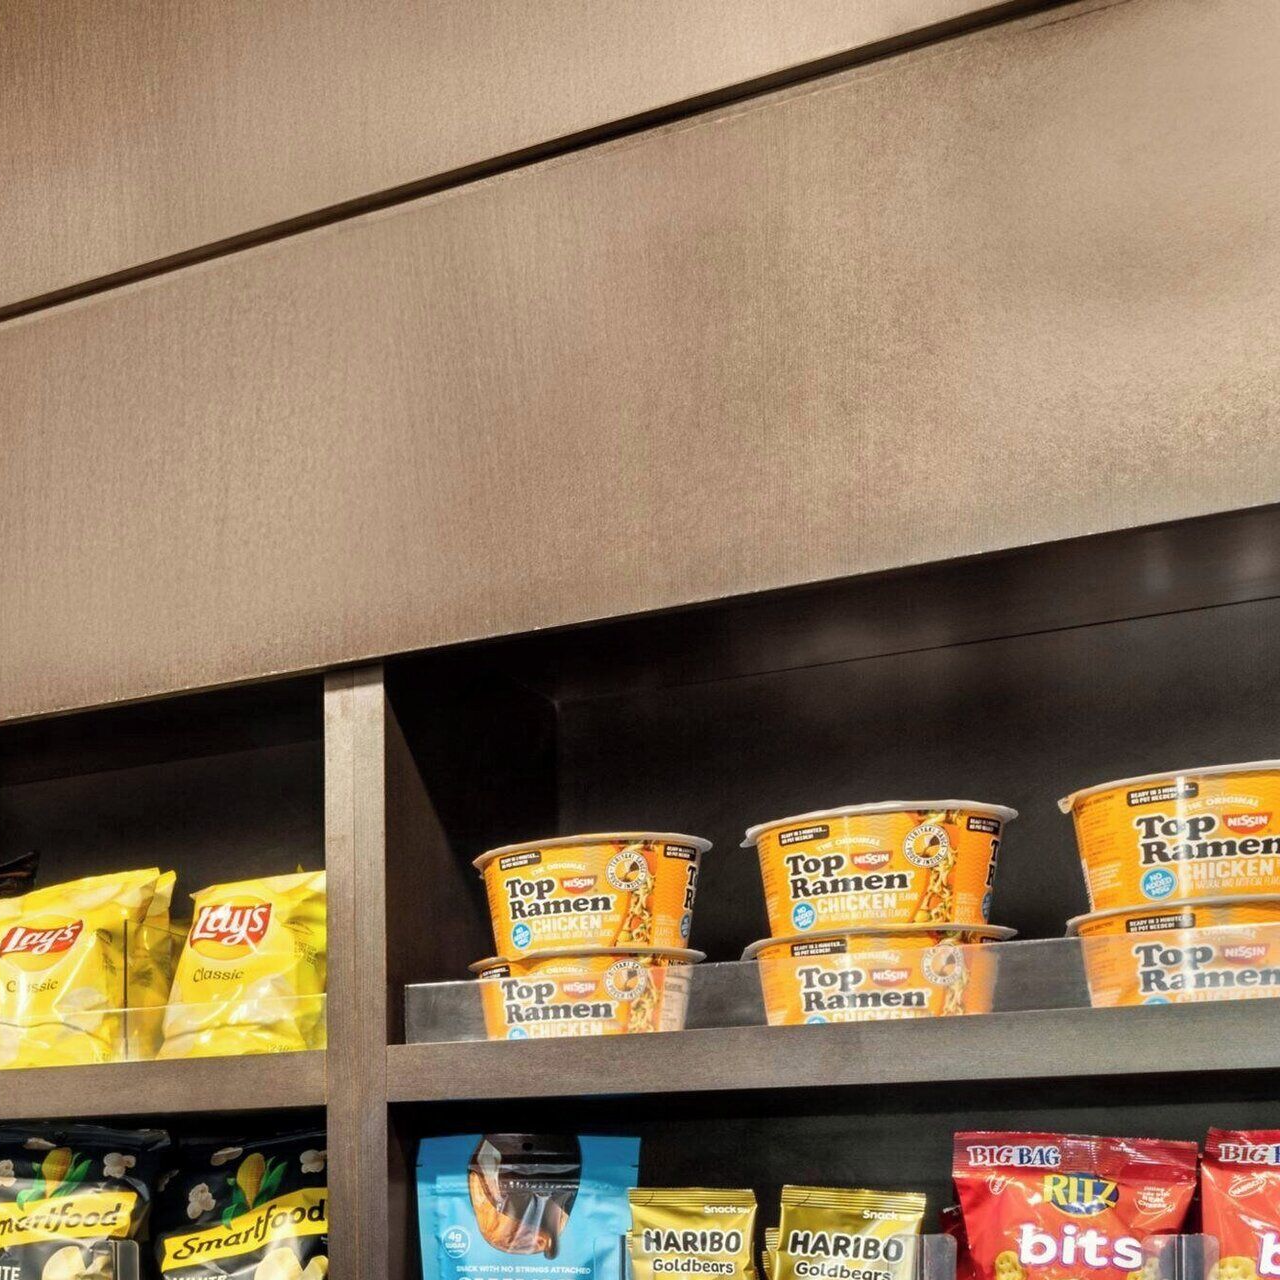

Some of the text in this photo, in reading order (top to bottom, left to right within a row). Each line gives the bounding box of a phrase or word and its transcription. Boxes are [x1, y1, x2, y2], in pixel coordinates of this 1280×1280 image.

[1135, 813, 1217, 841] Top
[1224, 813, 1269, 830] NISSIN
[786, 851, 845, 877] Top
[853, 854, 891, 868] NISSIN
[505, 877, 555, 900] Top
[789, 871, 913, 899] Ramen
[509, 894, 614, 920] Ramen
[817, 893, 897, 913] CHICKEN
[194, 902, 266, 945] Lay's
[533, 914, 602, 932] CHICKEN
[4, 922, 77, 954] Lay's
[192, 968, 244, 984] Classic
[506, 1001, 617, 1024] Ramen
[968, 1146, 1061, 1167] BIG BAG
[1219, 1144, 1270, 1163] BIG
[1043, 1174, 1119, 1207] RITZ
[704, 1205, 737, 1215] Snack
[862, 1209, 898, 1220] Snack
[172, 1199, 326, 1261] Smartfood
[446, 1231, 462, 1243] 4g
[644, 1230, 742, 1254] HARIBO
[788, 1231, 905, 1263] HARIBO
[1019, 1223, 1142, 1269] bits
[456, 1265, 592, 1275] SNACK WITH NO STRINGS ATTACHED
[652, 1258, 734, 1275] Goldbears
